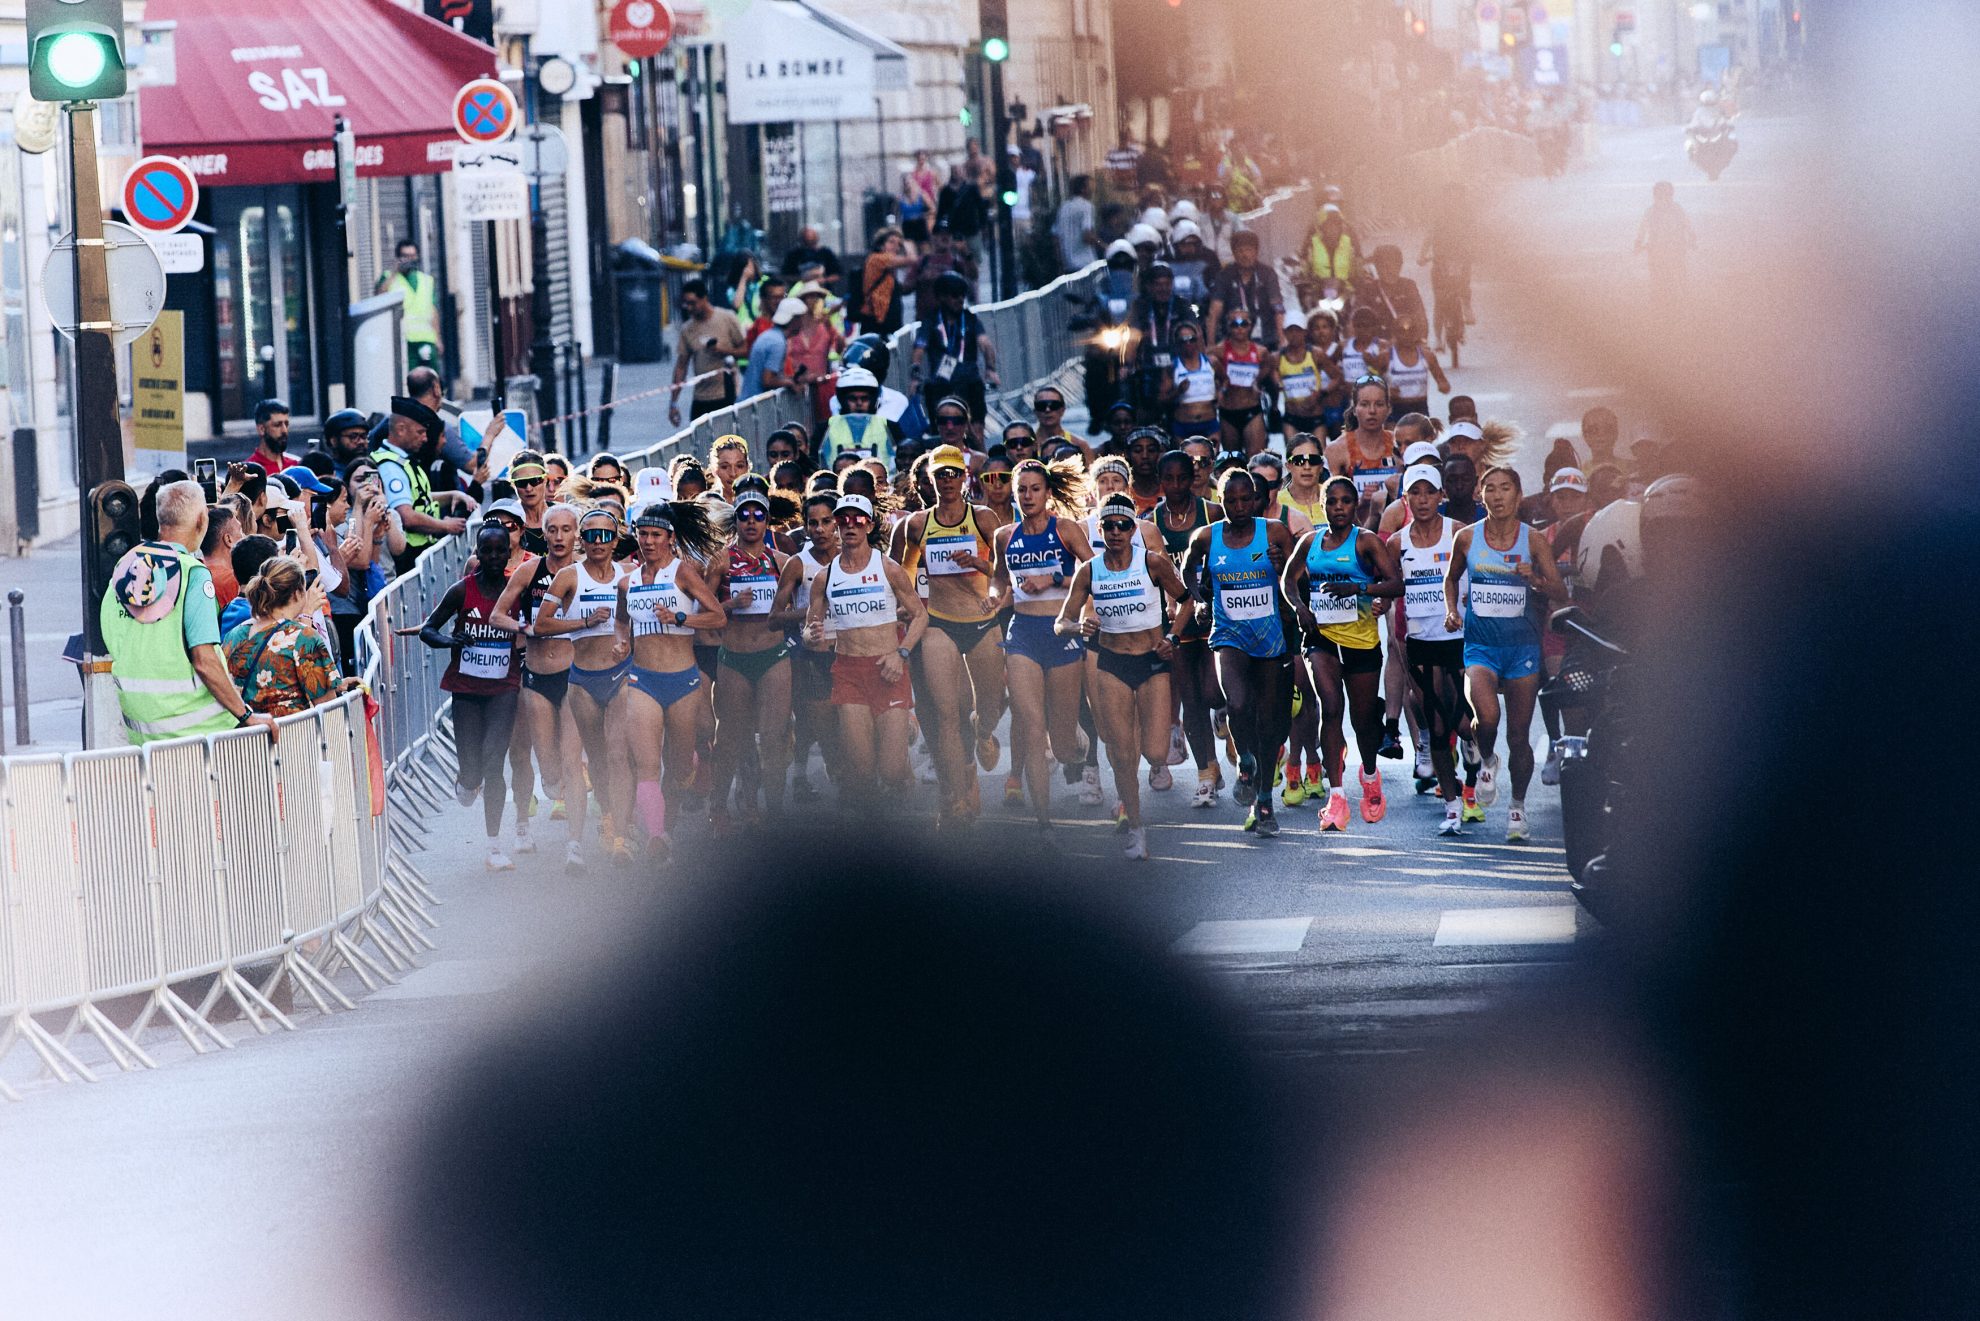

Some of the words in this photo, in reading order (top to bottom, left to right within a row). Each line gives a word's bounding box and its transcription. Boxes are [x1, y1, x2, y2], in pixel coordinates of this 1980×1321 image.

[745, 62, 767, 79] LA
[248, 68, 347, 111] SAZ
[1217, 570, 1267, 582] TANZANIA
[1411, 568, 1442, 578] MONGOLIA
[1099, 578, 1142, 591] ARGENTINA
[1226, 593, 1269, 609] SAKILU
[1471, 590, 1525, 606] GALBADRAKH
[834, 599, 886, 616] ELMORE
[1095, 602, 1146, 618] OCAMPO
[462, 650, 510, 667] CHELIMO
